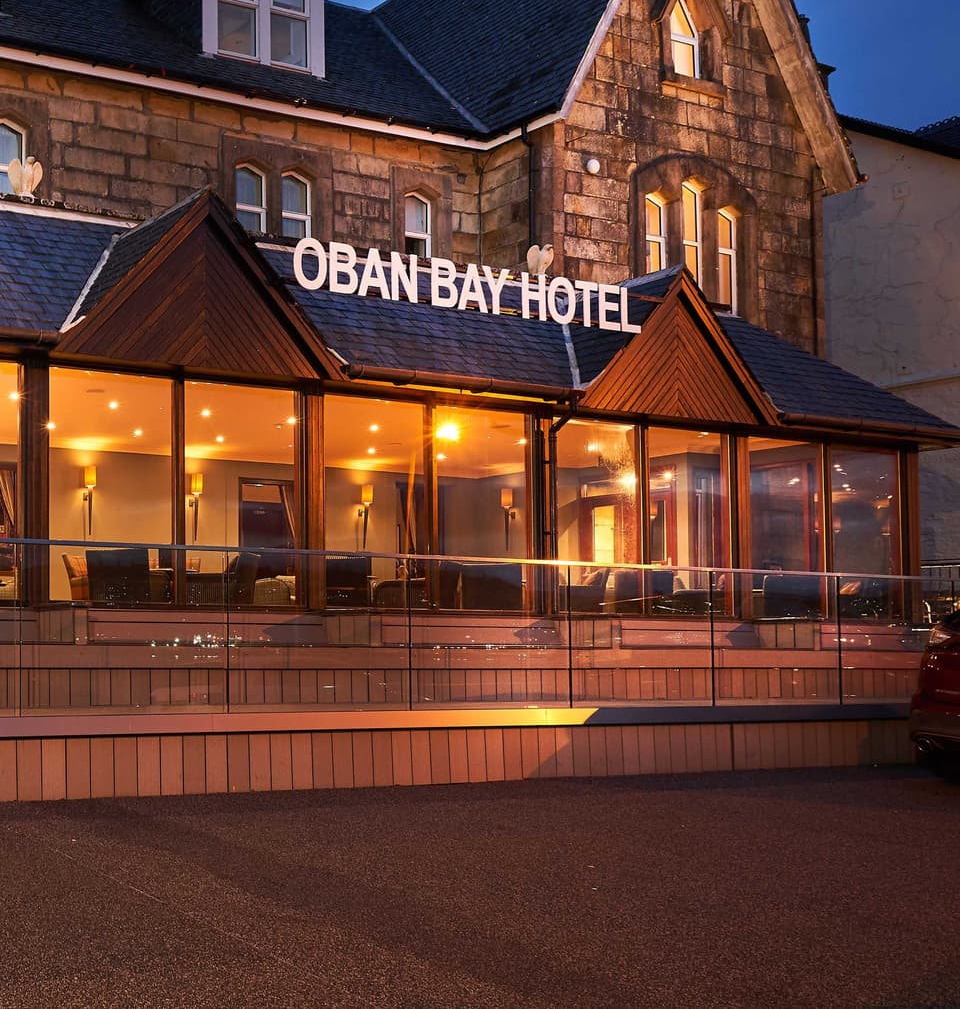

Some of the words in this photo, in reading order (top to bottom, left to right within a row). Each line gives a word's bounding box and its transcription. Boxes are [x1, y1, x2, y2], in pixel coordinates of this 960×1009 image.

[293, 237, 418, 303] OBAN
[431, 257, 510, 315] BAY
[521, 272, 641, 334] HOTEL
